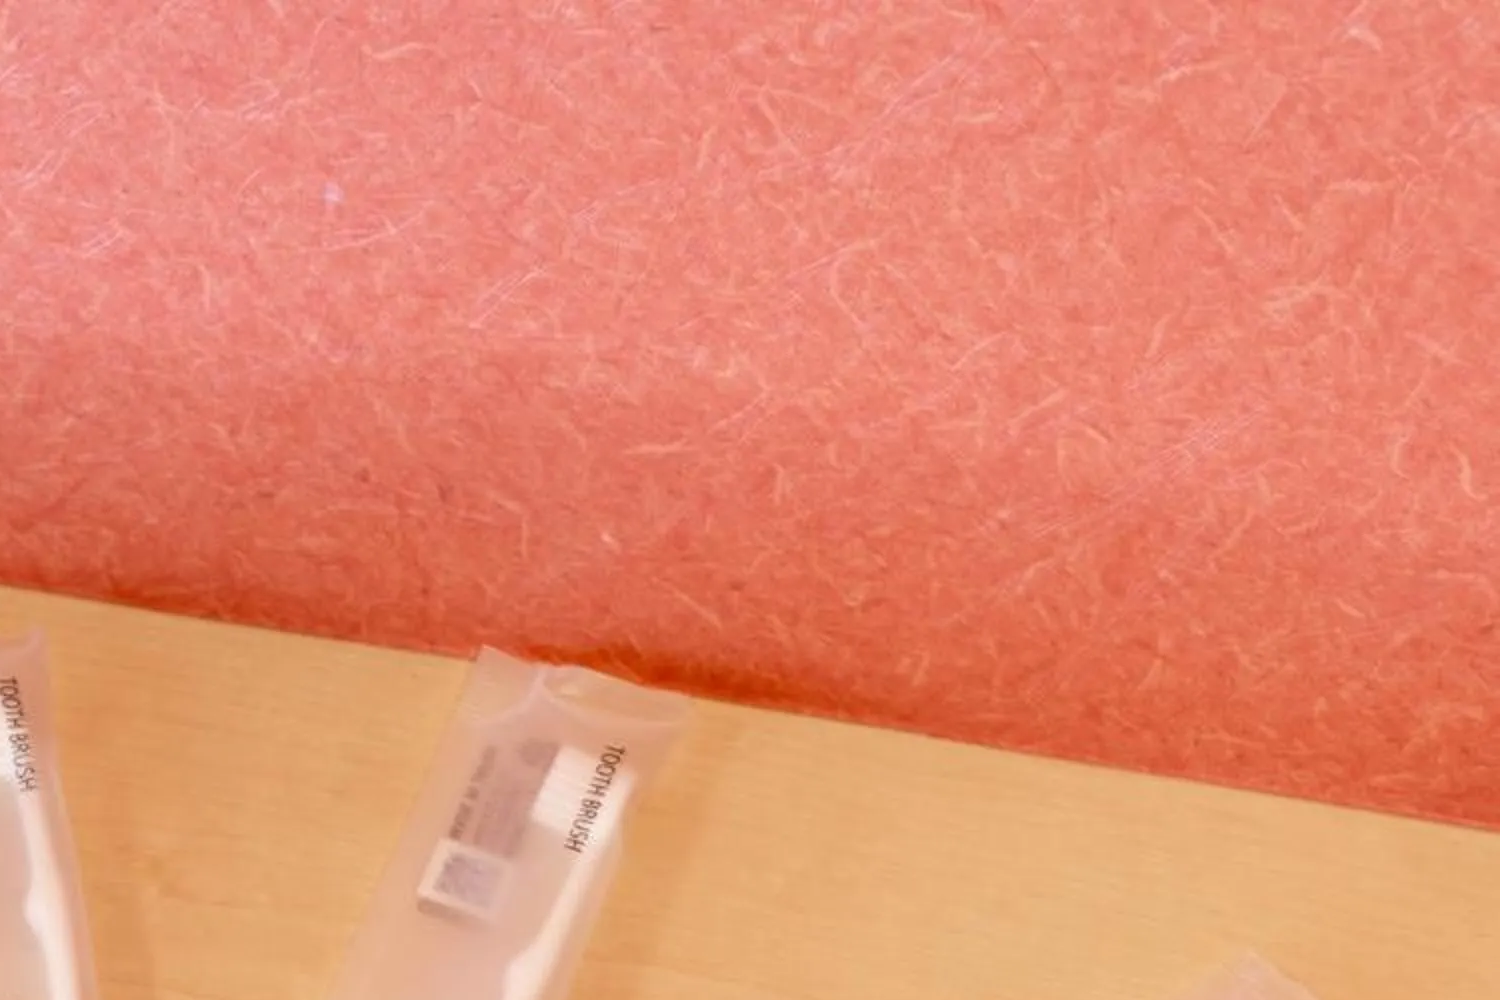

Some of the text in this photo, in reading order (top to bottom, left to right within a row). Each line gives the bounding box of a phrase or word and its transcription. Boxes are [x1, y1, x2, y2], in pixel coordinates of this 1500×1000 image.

[6, 731, 38, 794] BRUSH
[562, 744, 627, 855] TOOTH BRUSH
